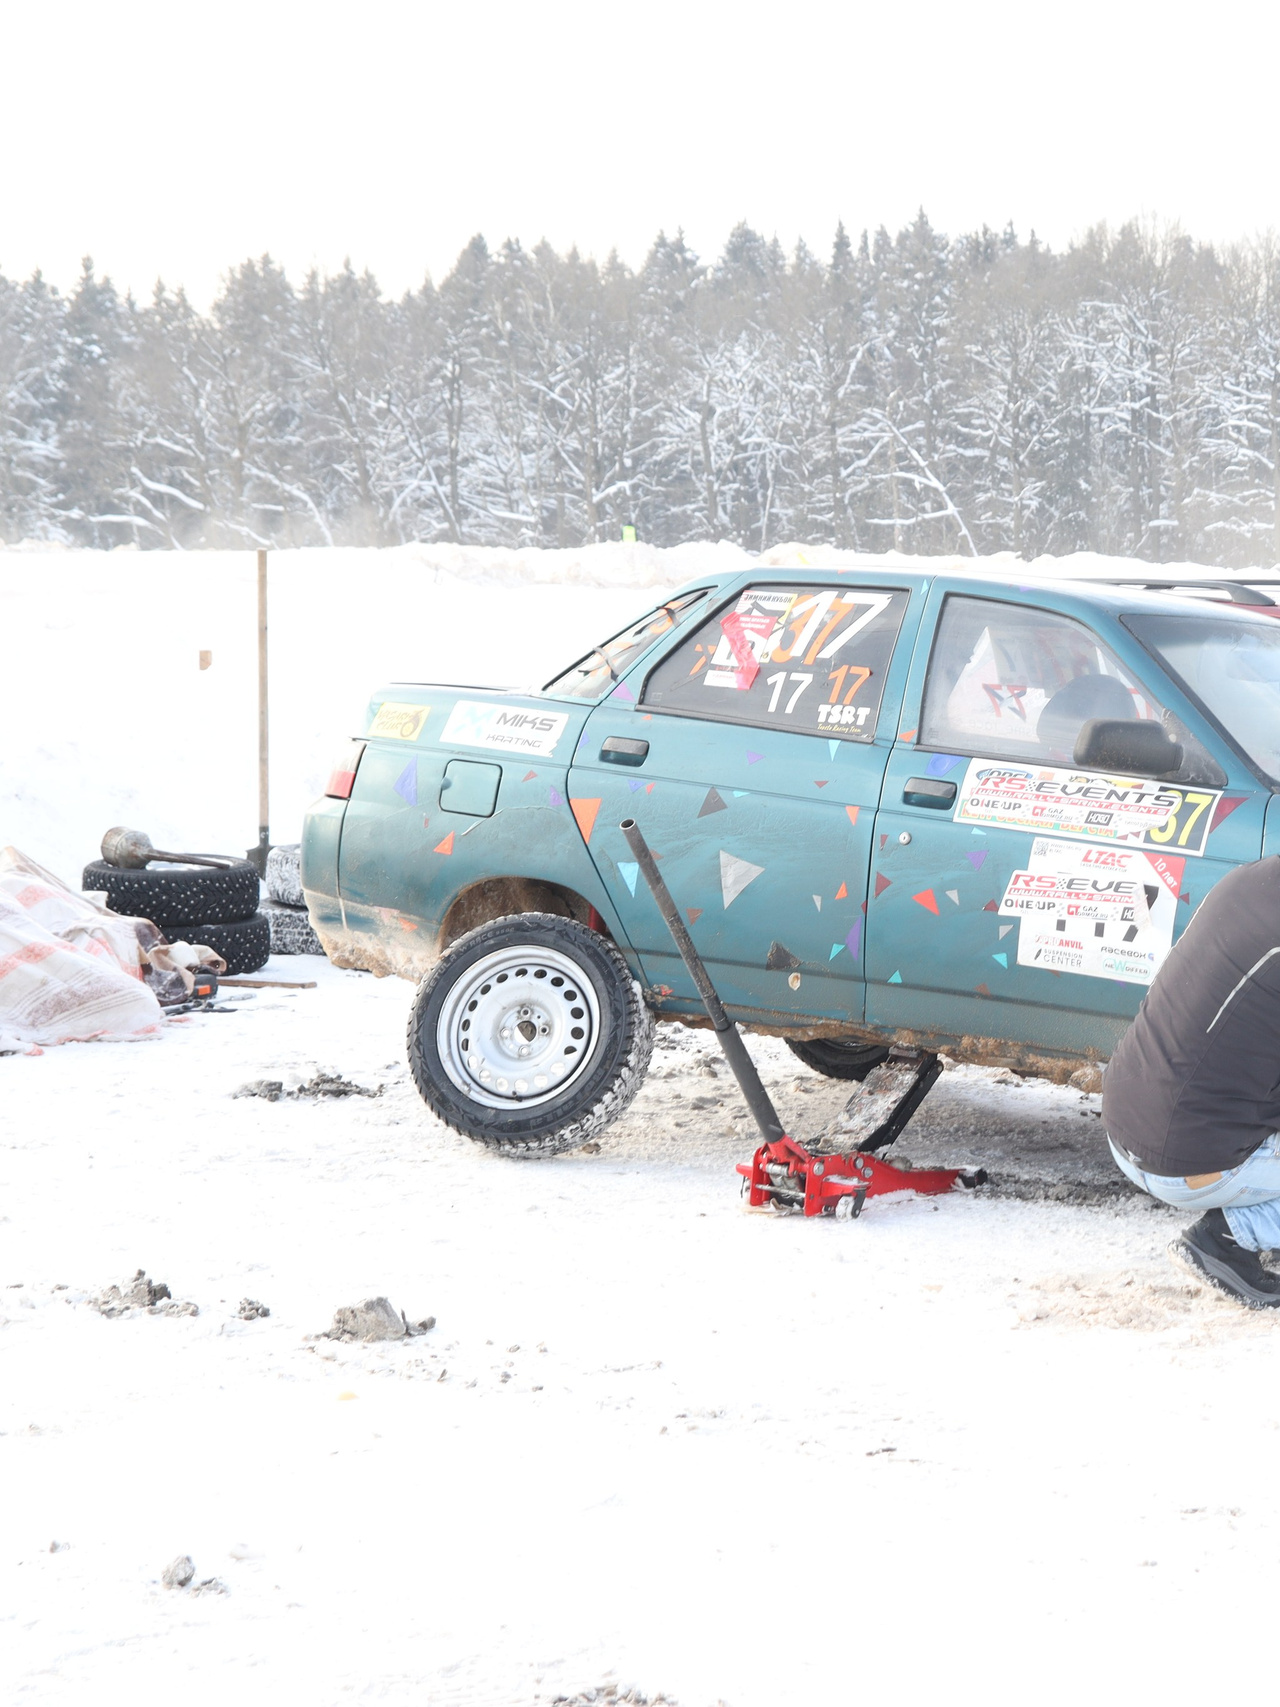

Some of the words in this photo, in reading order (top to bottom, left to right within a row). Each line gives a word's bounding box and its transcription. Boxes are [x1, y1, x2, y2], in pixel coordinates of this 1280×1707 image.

[791, 590, 894, 658] 17
[766, 671, 814, 714] 17
[828, 664, 872, 705] 17
[496, 712, 557, 732] MIKS
[817, 704, 871, 726] TSRT
[486, 733, 543, 749] KARTING
[980, 777, 1028, 792] RS
[1035, 781, 1178, 808] EVENTS
[1082, 849, 1133, 868] LTAC
[1154, 857, 1167, 872] 10
[1012, 874, 1058, 888] RS
[425, 953, 457, 995] SETULA
[469, 931, 494, 948] RACE
[1043, 954, 1082, 968] CENTER
[1044, 948, 1083, 959] SUSPENSION
